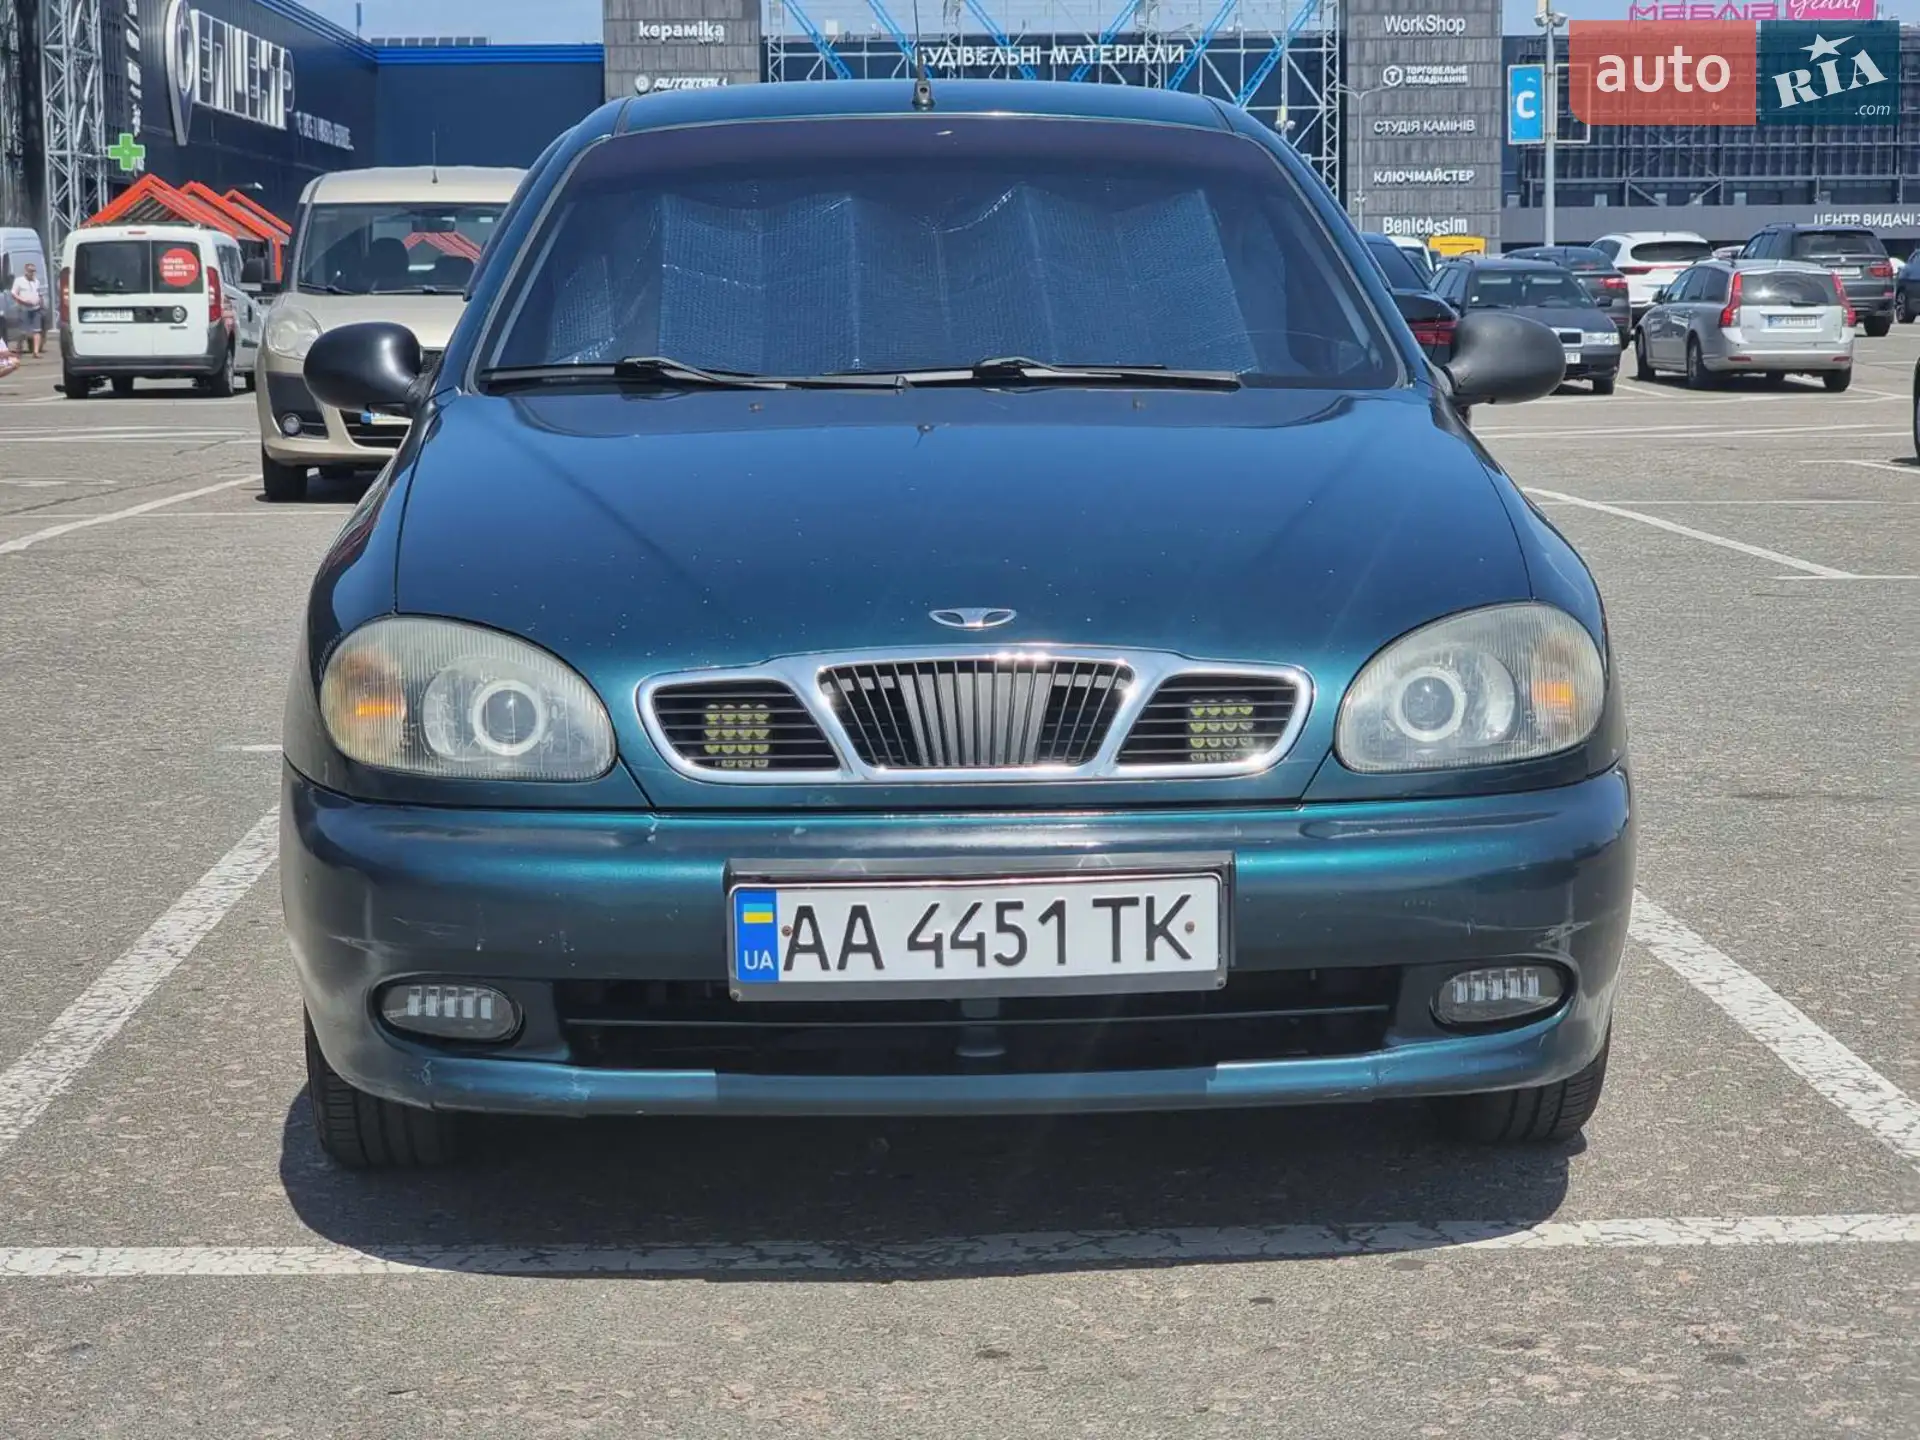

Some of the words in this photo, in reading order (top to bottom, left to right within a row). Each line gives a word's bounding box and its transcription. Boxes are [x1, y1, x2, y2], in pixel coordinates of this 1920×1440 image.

[1384, 14, 1466, 36] WorkShop
[1050, 44, 1185, 65] МАТЕРІАЛИ
[1373, 120, 1420, 133] СТУДІЯ
[1423, 119, 1475, 131] КАМІНІВ
[1373, 168, 1475, 182] КЛЮЧМАЙСТЕР
[1814, 213, 1860, 225] ЦЕНТР
[1863, 212, 1915, 228] ВИДАЧІ
[783, 905, 885, 971] AA
[906, 900, 1067, 969] 4451
[1092, 894, 1193, 963] TK
[744, 950, 774, 971] UA
